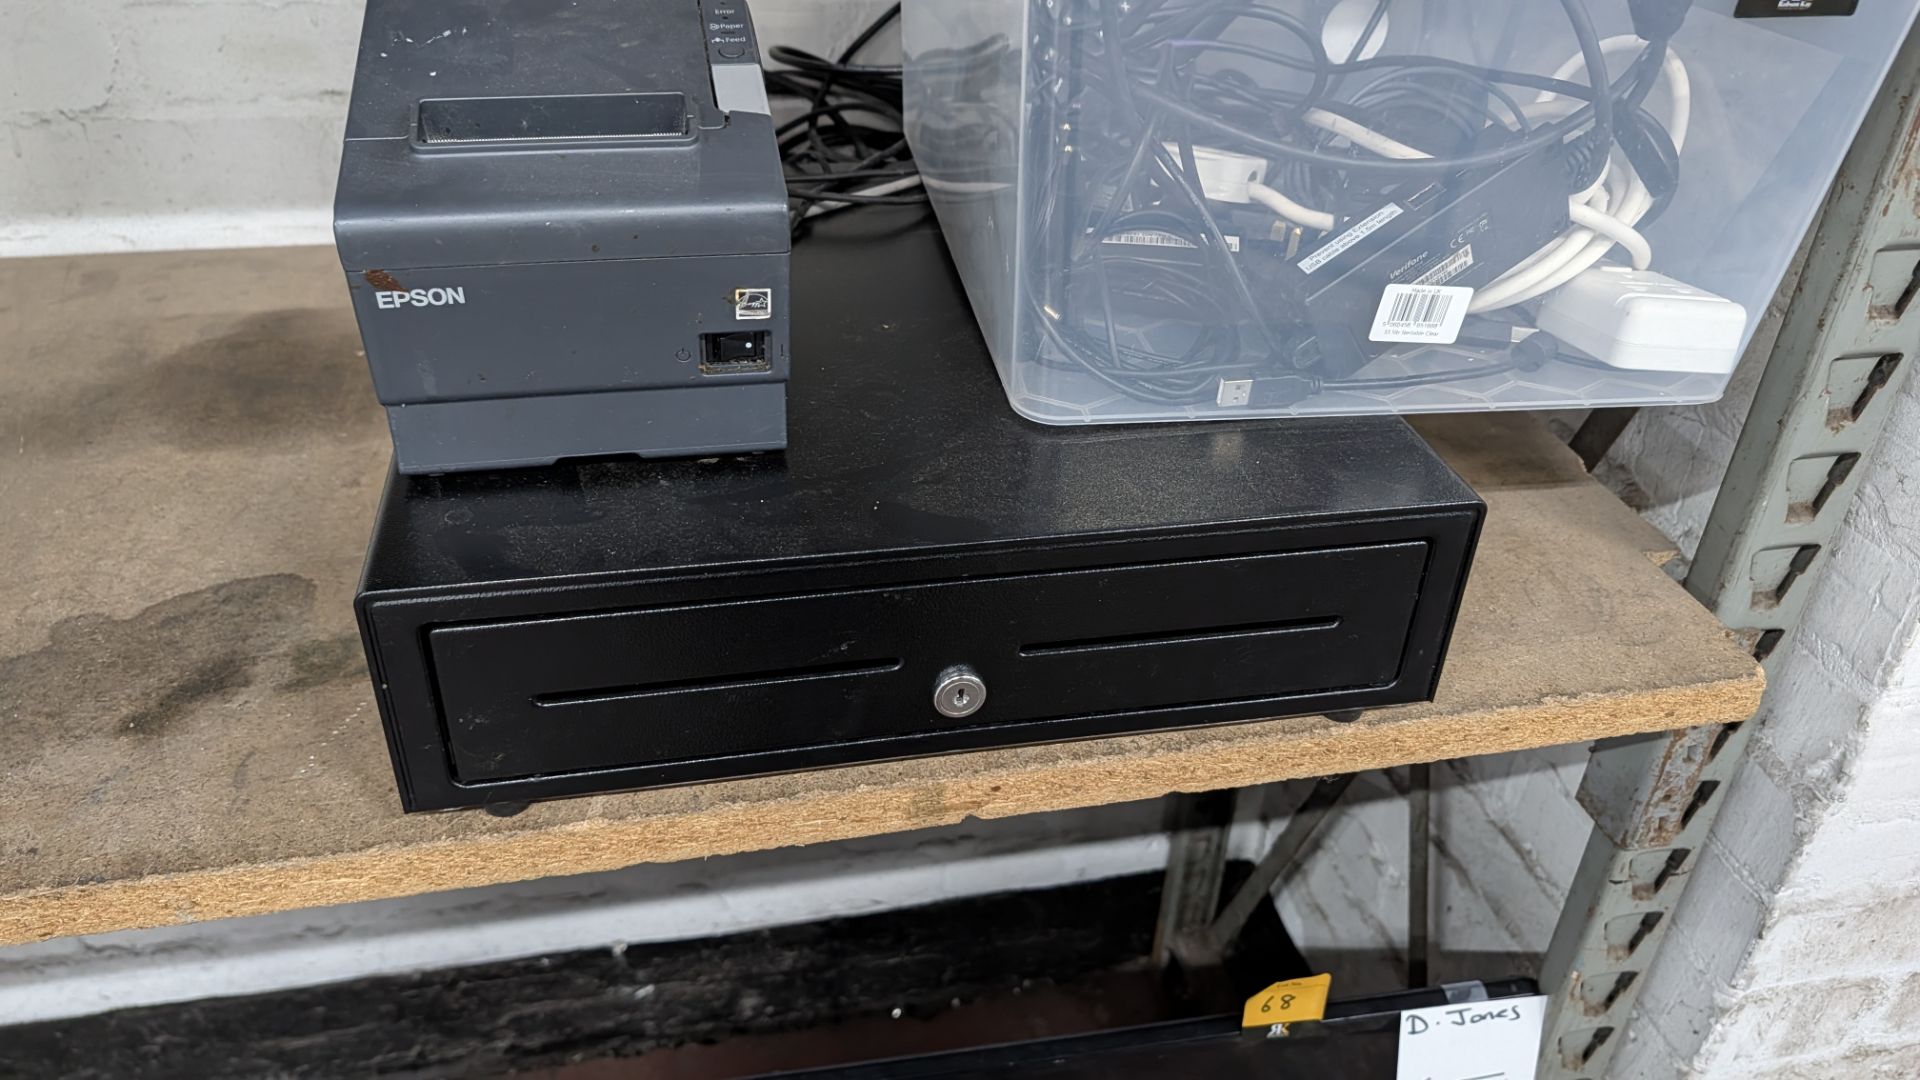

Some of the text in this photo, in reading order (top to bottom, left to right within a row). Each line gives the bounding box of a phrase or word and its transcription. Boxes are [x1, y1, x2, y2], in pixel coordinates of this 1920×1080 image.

[1305, 258, 1322, 271] USB
[1340, 234, 1360, 249] above
[1308, 243, 1334, 261] Prevent
[1334, 231, 1353, 245] using
[1389, 250, 1429, 279] Verifone
[375, 286, 466, 309] EPSON
[1261, 994, 1296, 1013] 68
[1445, 1005, 1521, 1026] Jones
